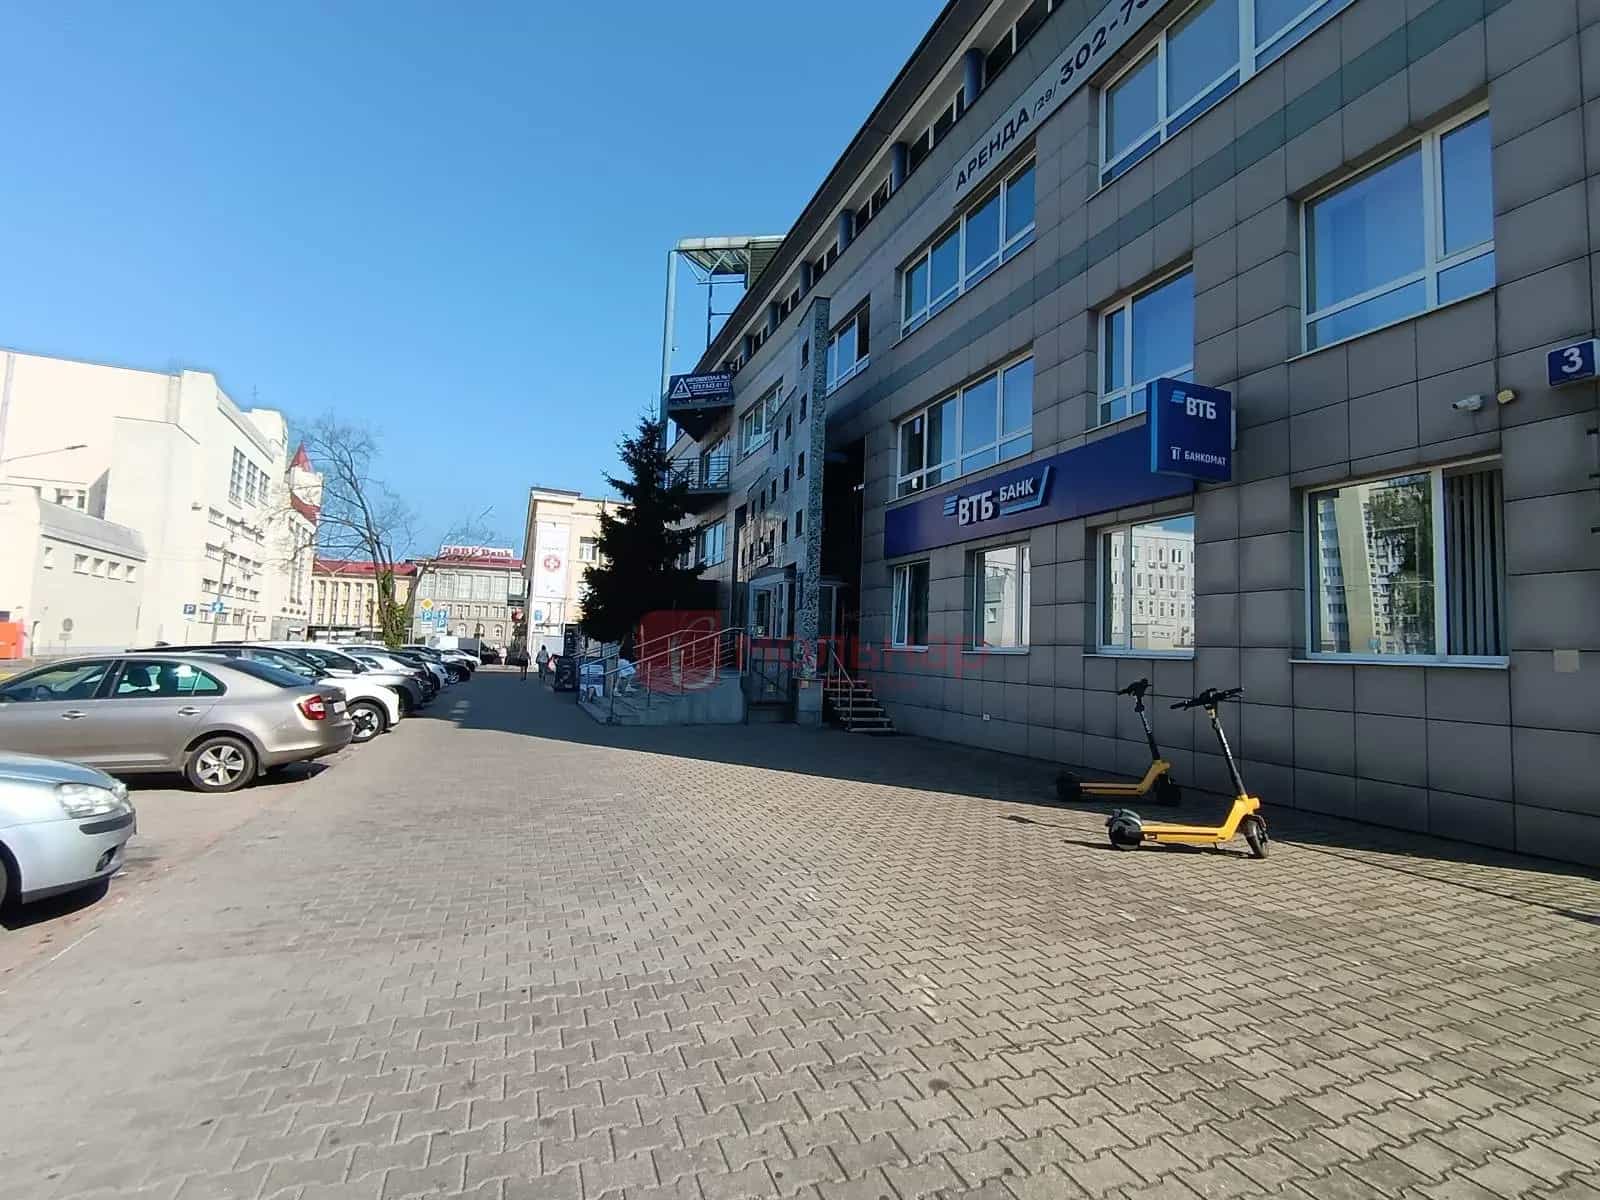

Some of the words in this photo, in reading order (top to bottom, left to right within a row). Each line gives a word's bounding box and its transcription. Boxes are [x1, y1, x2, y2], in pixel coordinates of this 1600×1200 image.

[955, 107, 1029, 192] АРЕНДА
[1561, 347, 1583, 373] 3
[1186, 397, 1217, 420] ВТБ
[1184, 450, 1226, 465] БАНКОМАТ
[957, 489, 994, 526] ВТБ
[999, 477, 1035, 502] БАНК
